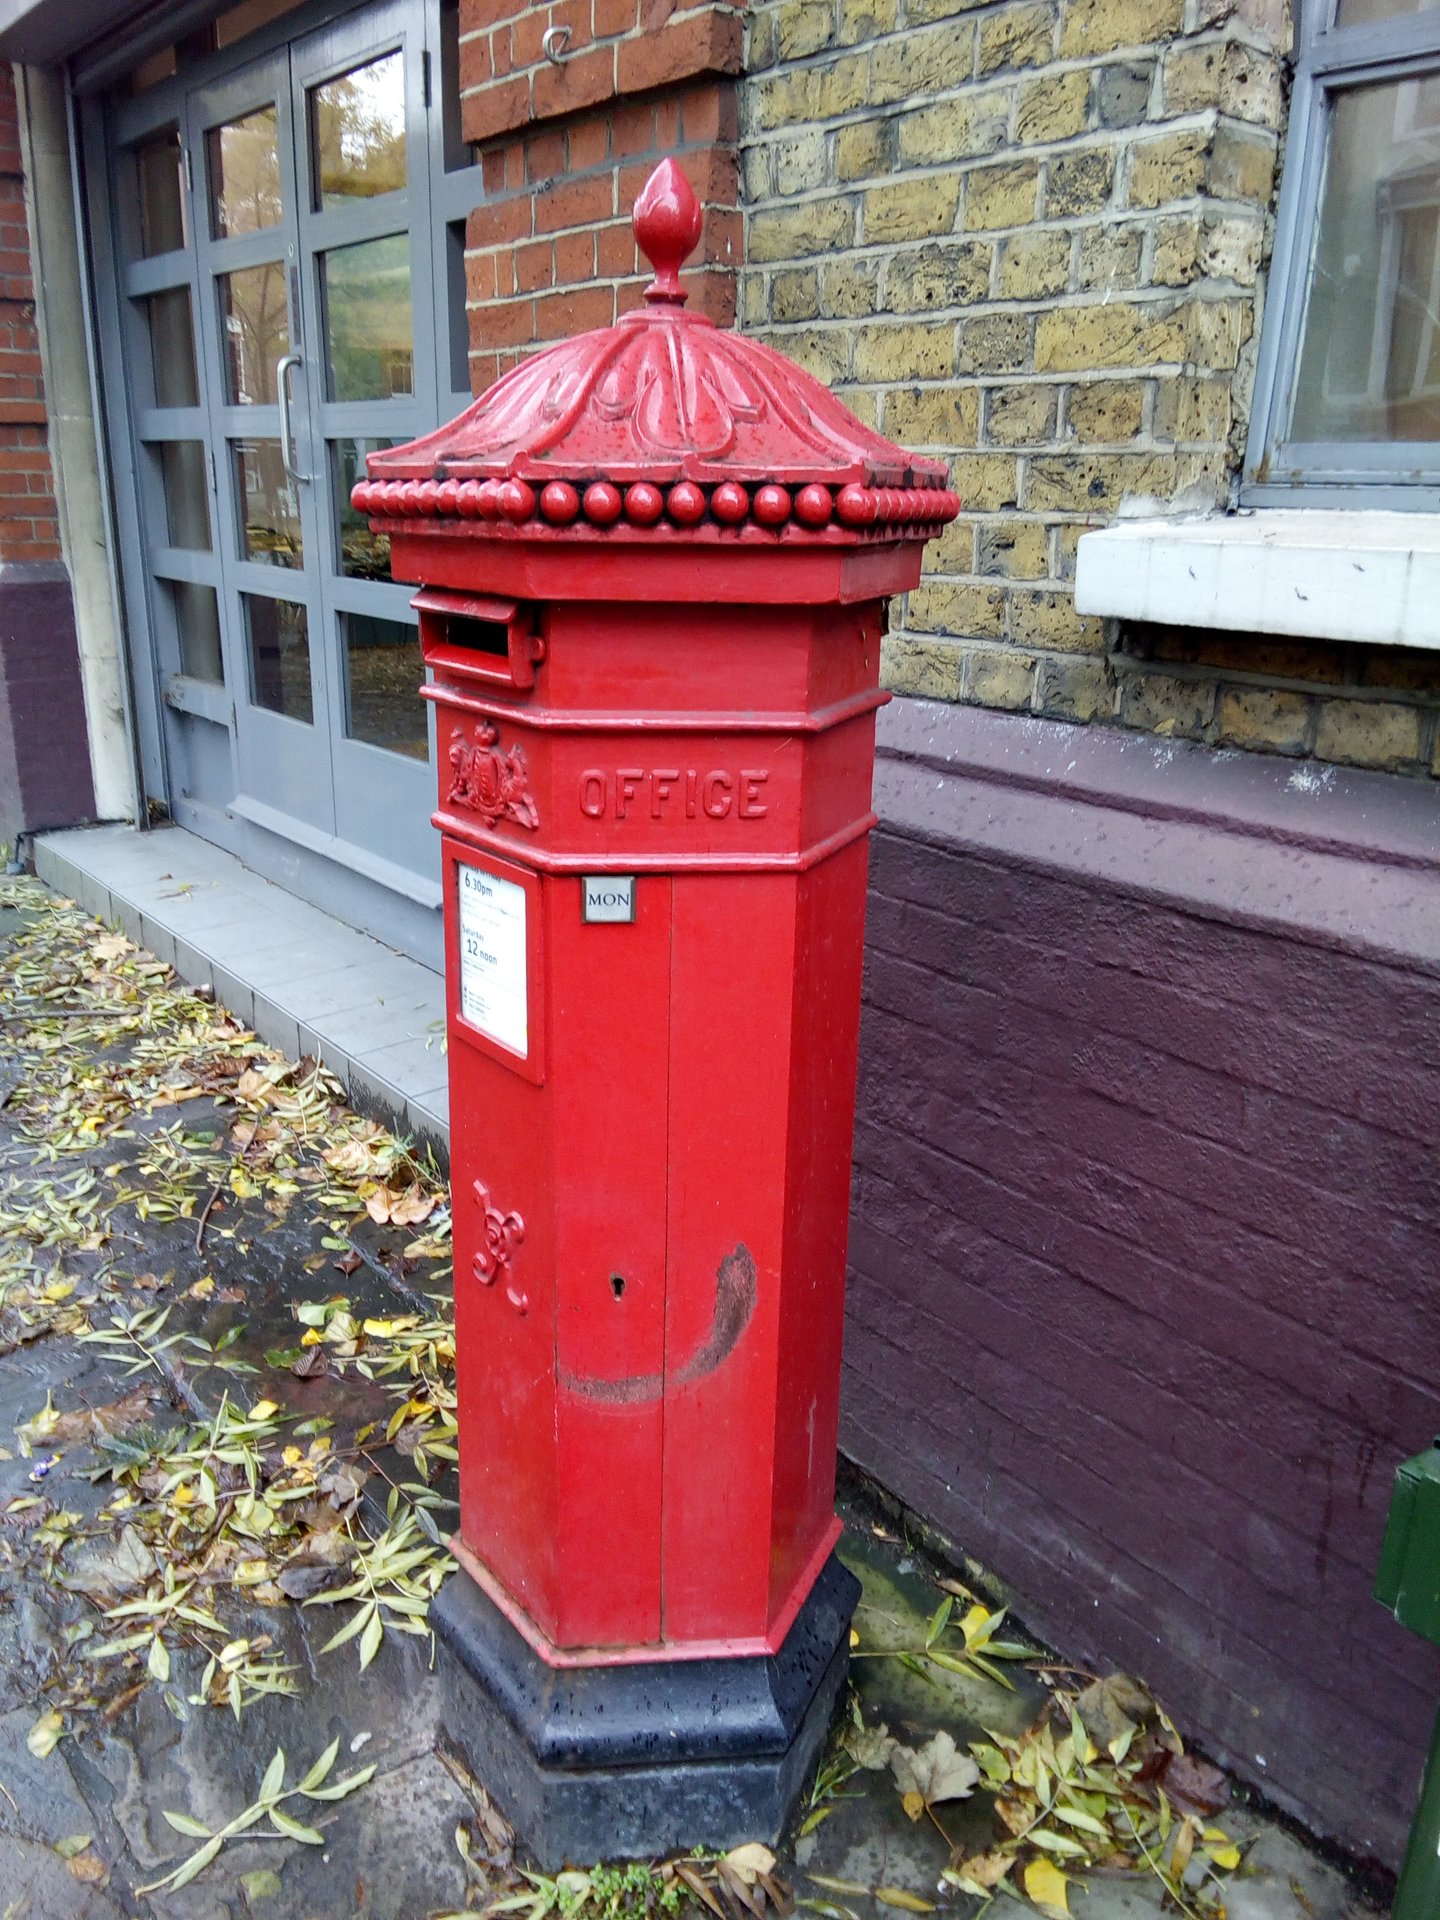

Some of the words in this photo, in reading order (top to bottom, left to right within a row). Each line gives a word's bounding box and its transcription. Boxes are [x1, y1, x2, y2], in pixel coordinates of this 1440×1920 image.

[579, 768, 769, 818] OFFICE
[465, 872, 493, 896] 6.30pm
[588, 893, 630, 906] MON
[467, 938, 478, 957] 12
[480, 950, 498, 965] noon
